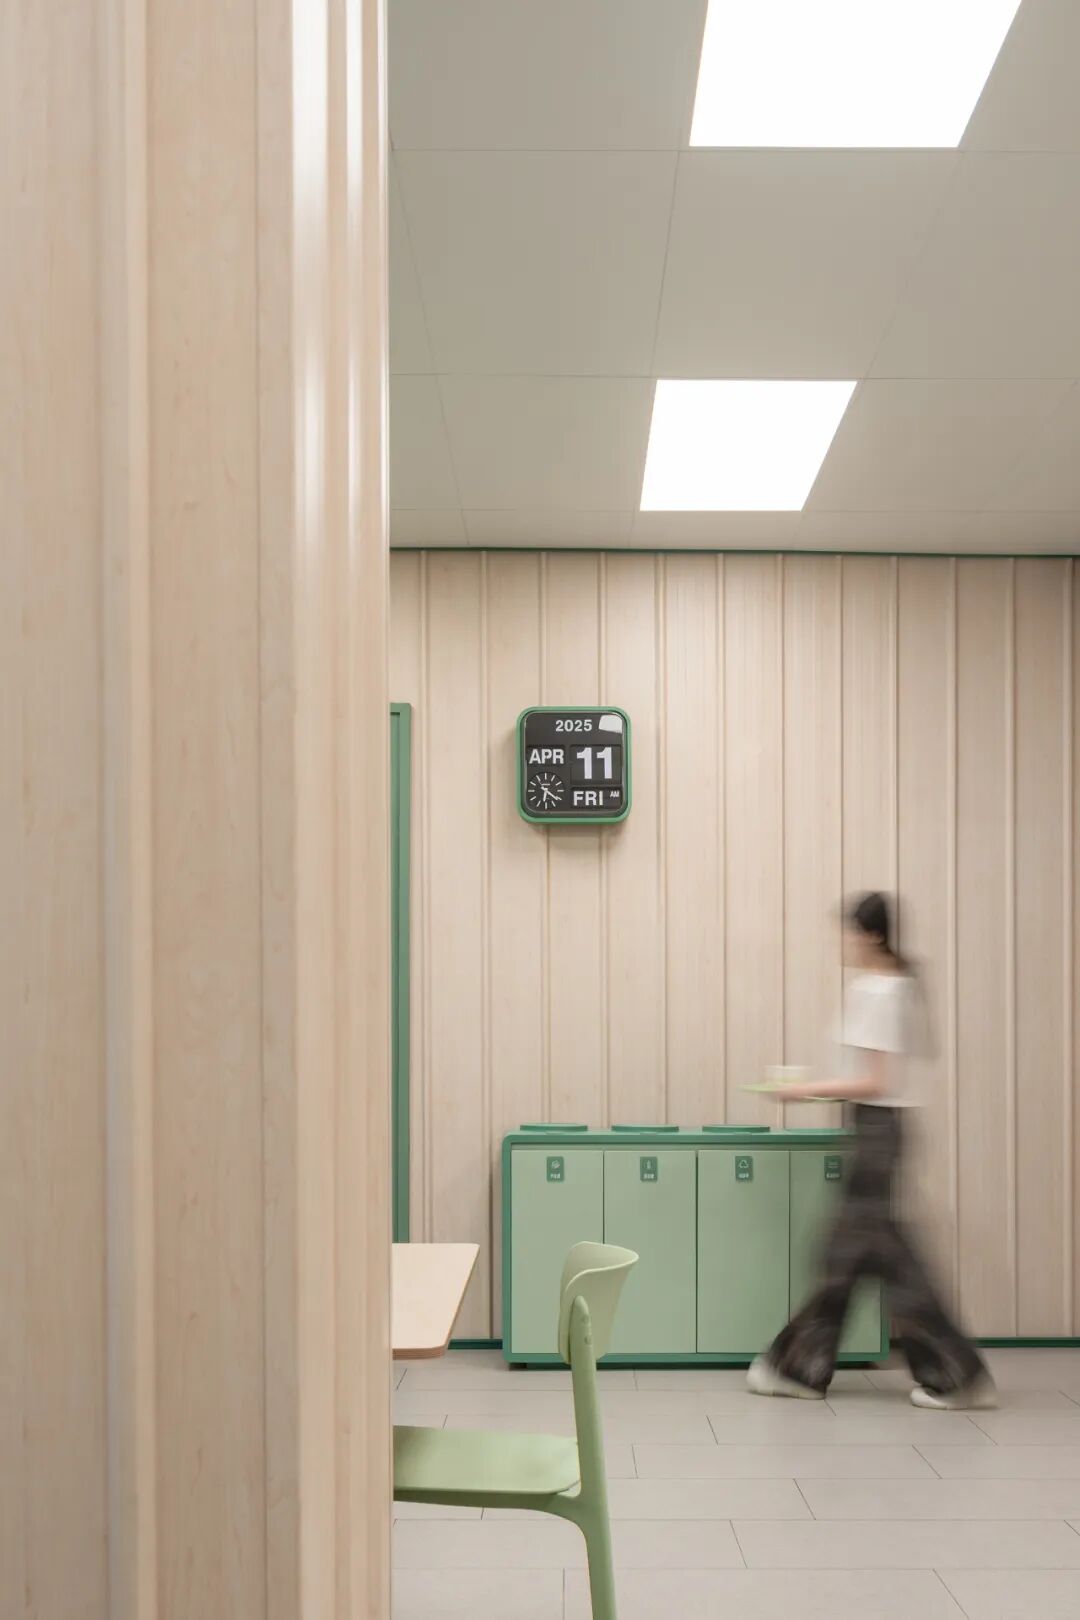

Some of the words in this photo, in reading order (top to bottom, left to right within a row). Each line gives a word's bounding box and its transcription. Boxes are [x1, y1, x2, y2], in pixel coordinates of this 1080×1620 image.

[555, 719, 592, 732] 2025
[529, 748, 564, 764] APR
[576, 747, 612, 779] 11
[573, 790, 603, 806] FRI
